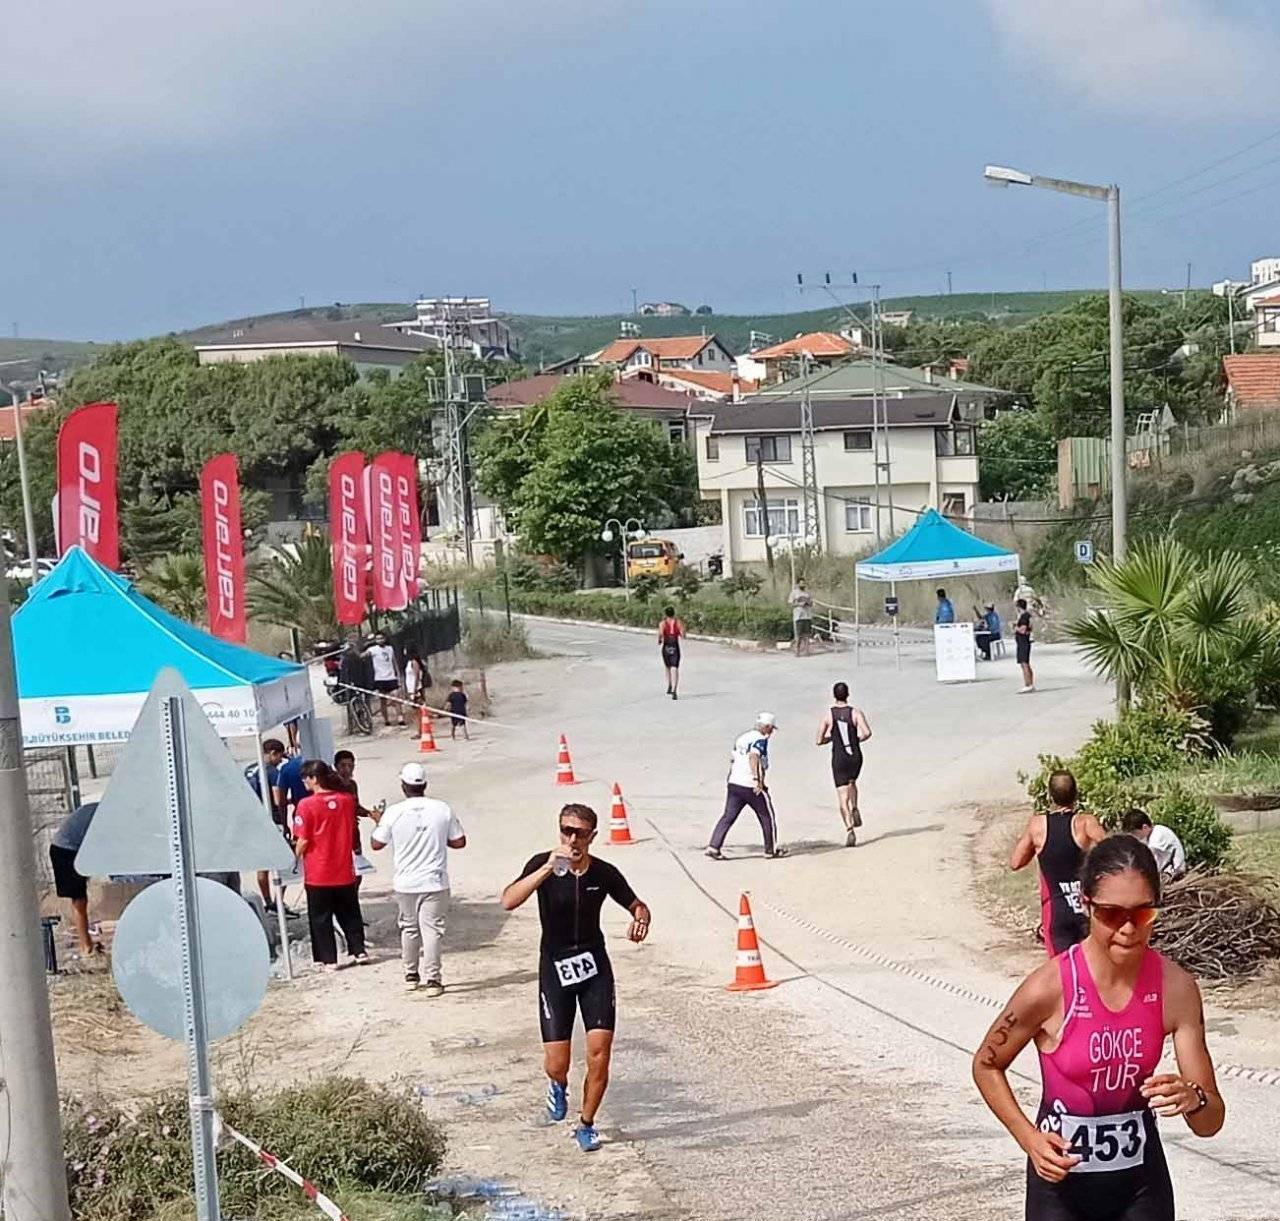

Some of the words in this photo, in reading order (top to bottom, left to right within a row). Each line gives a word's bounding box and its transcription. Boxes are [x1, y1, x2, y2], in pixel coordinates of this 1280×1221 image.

[213, 479, 234, 619] carraro
[341, 473, 357, 602] carraro
[379, 472, 395, 589] carraro
[1090, 1025, 1143, 1065] GÖKÇE
[1091, 1064, 1140, 1092] TUR
[1067, 1119, 1142, 1162] 453
